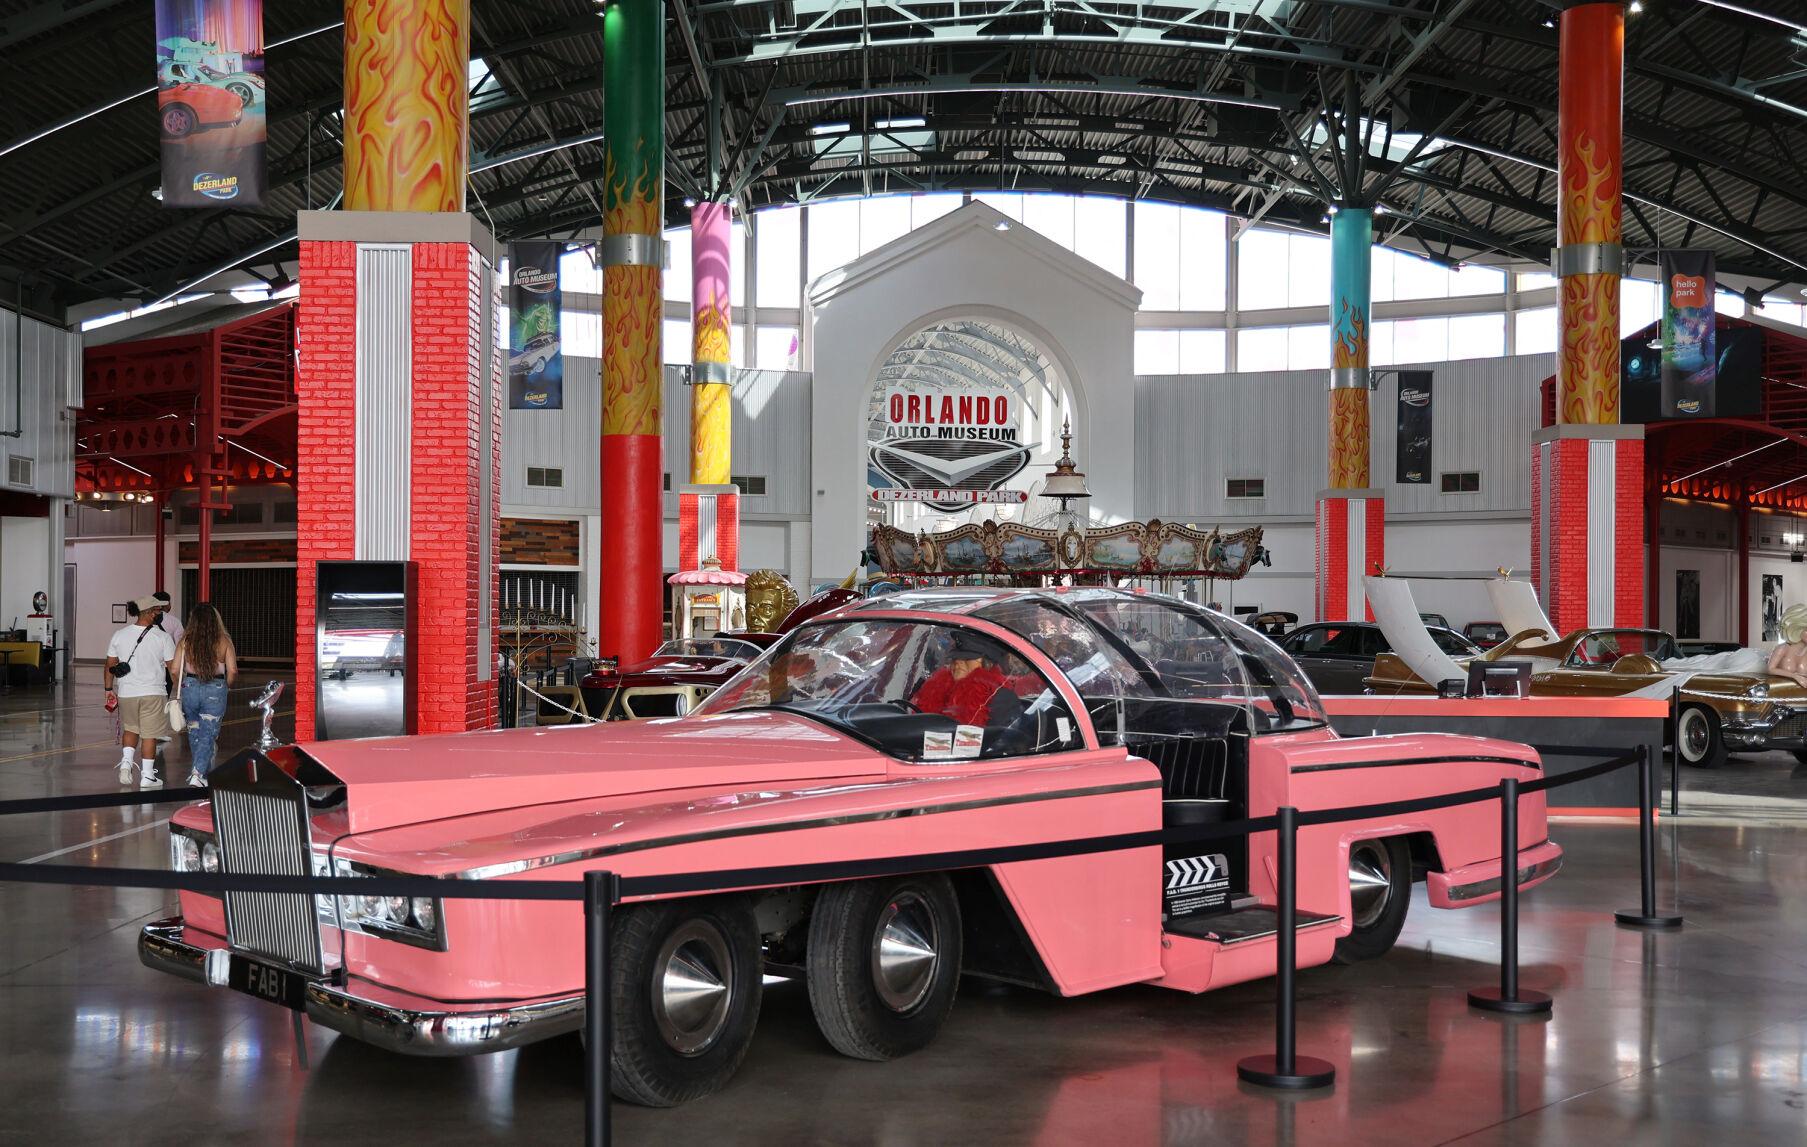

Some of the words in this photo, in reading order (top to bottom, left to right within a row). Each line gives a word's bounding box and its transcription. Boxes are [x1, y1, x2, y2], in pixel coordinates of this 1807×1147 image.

[193, 176, 237, 191] DEZERLAND
[513, 277, 529, 285] AUTO
[530, 273, 558, 283] MUSEUM
[518, 269, 541, 278] ORLANDO
[1676, 280, 1696, 288] hello
[1676, 289, 1696, 298] park
[890, 393, 1008, 426] ORLANDO
[886, 426, 931, 438] AUTO
[938, 426, 1016, 440] MUSEUM
[879, 490, 973, 502] DEZERLAND
[976, 490, 1022, 503] PARK
